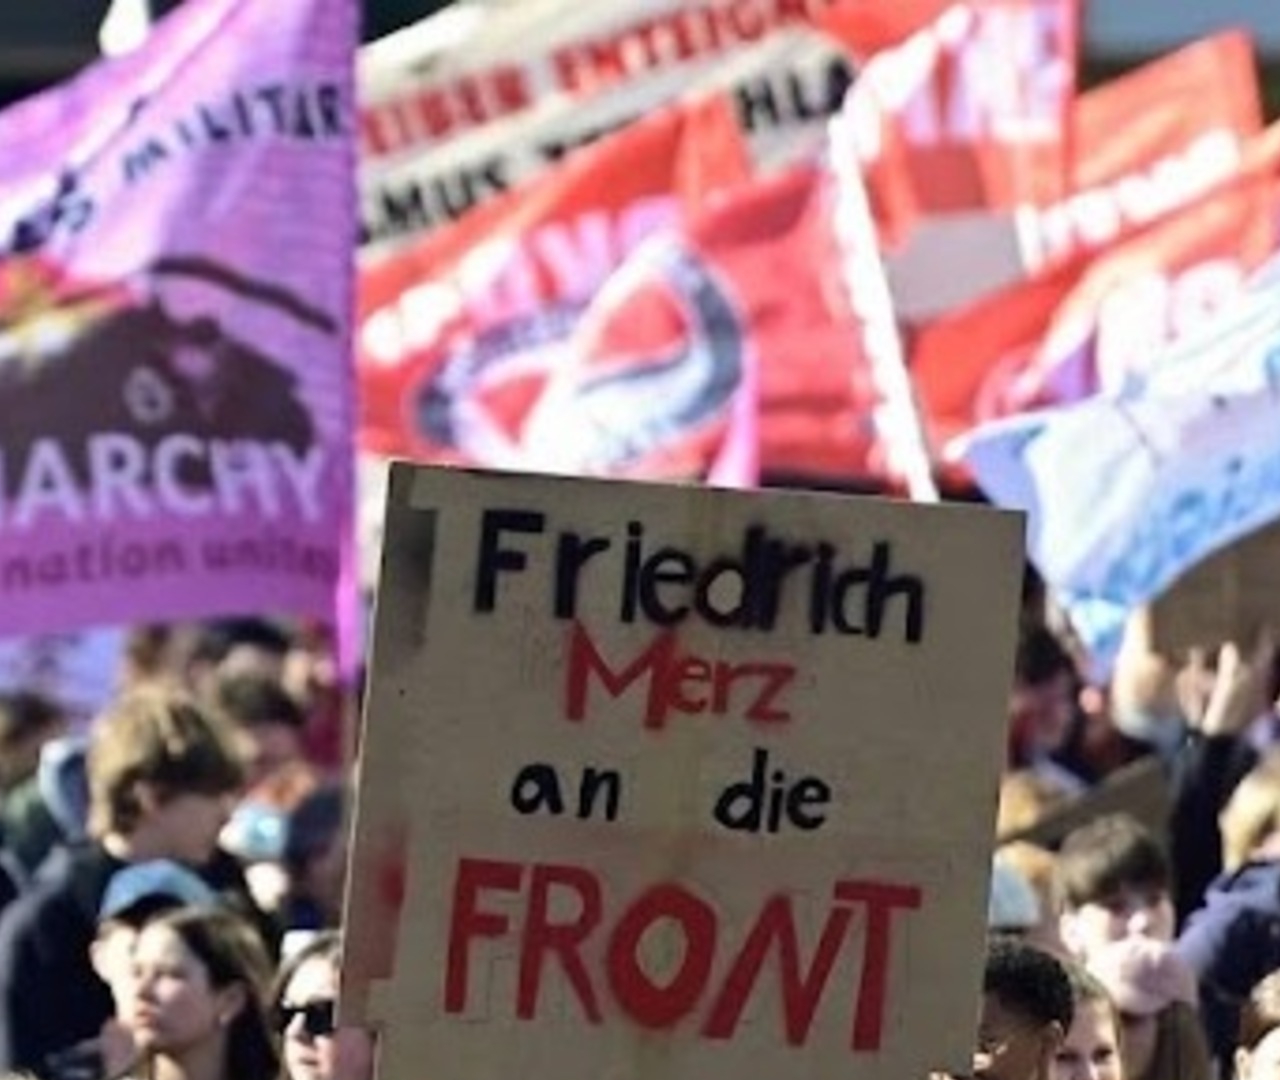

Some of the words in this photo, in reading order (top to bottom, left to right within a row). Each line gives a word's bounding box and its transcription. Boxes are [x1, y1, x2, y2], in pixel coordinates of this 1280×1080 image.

[0, 538, 186, 592] nation
[471, 508, 924, 643] Friedrich
[562, 622, 800, 731] Merz
[510, 761, 621, 822] an
[714, 747, 833, 833] die
[442, 855, 923, 1053] FRONT
